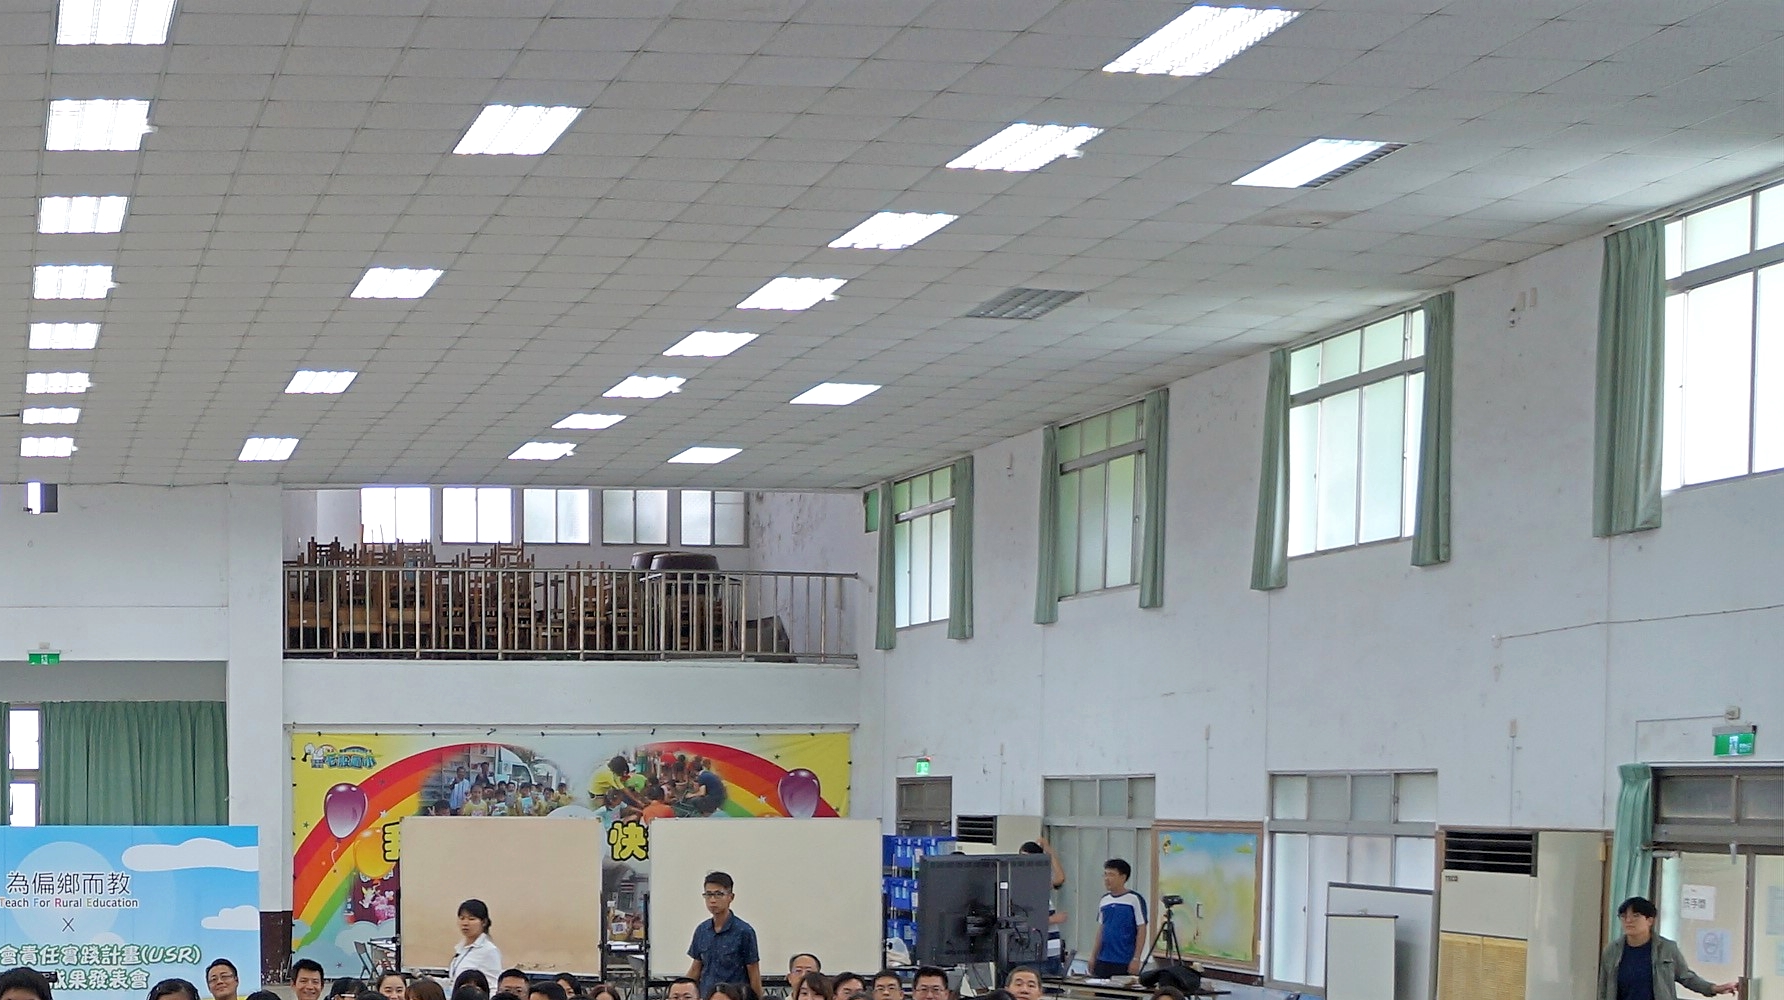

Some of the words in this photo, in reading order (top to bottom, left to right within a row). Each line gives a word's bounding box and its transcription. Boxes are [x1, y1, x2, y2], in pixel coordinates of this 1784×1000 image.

[608, 820, 649, 861] 快
[6, 872, 131, 895] 為偏鄉而教
[0, 898, 29, 908] Teach
[34, 898, 51, 908] For
[55, 898, 82, 908] Rural
[87, 898, 138, 908] Education
